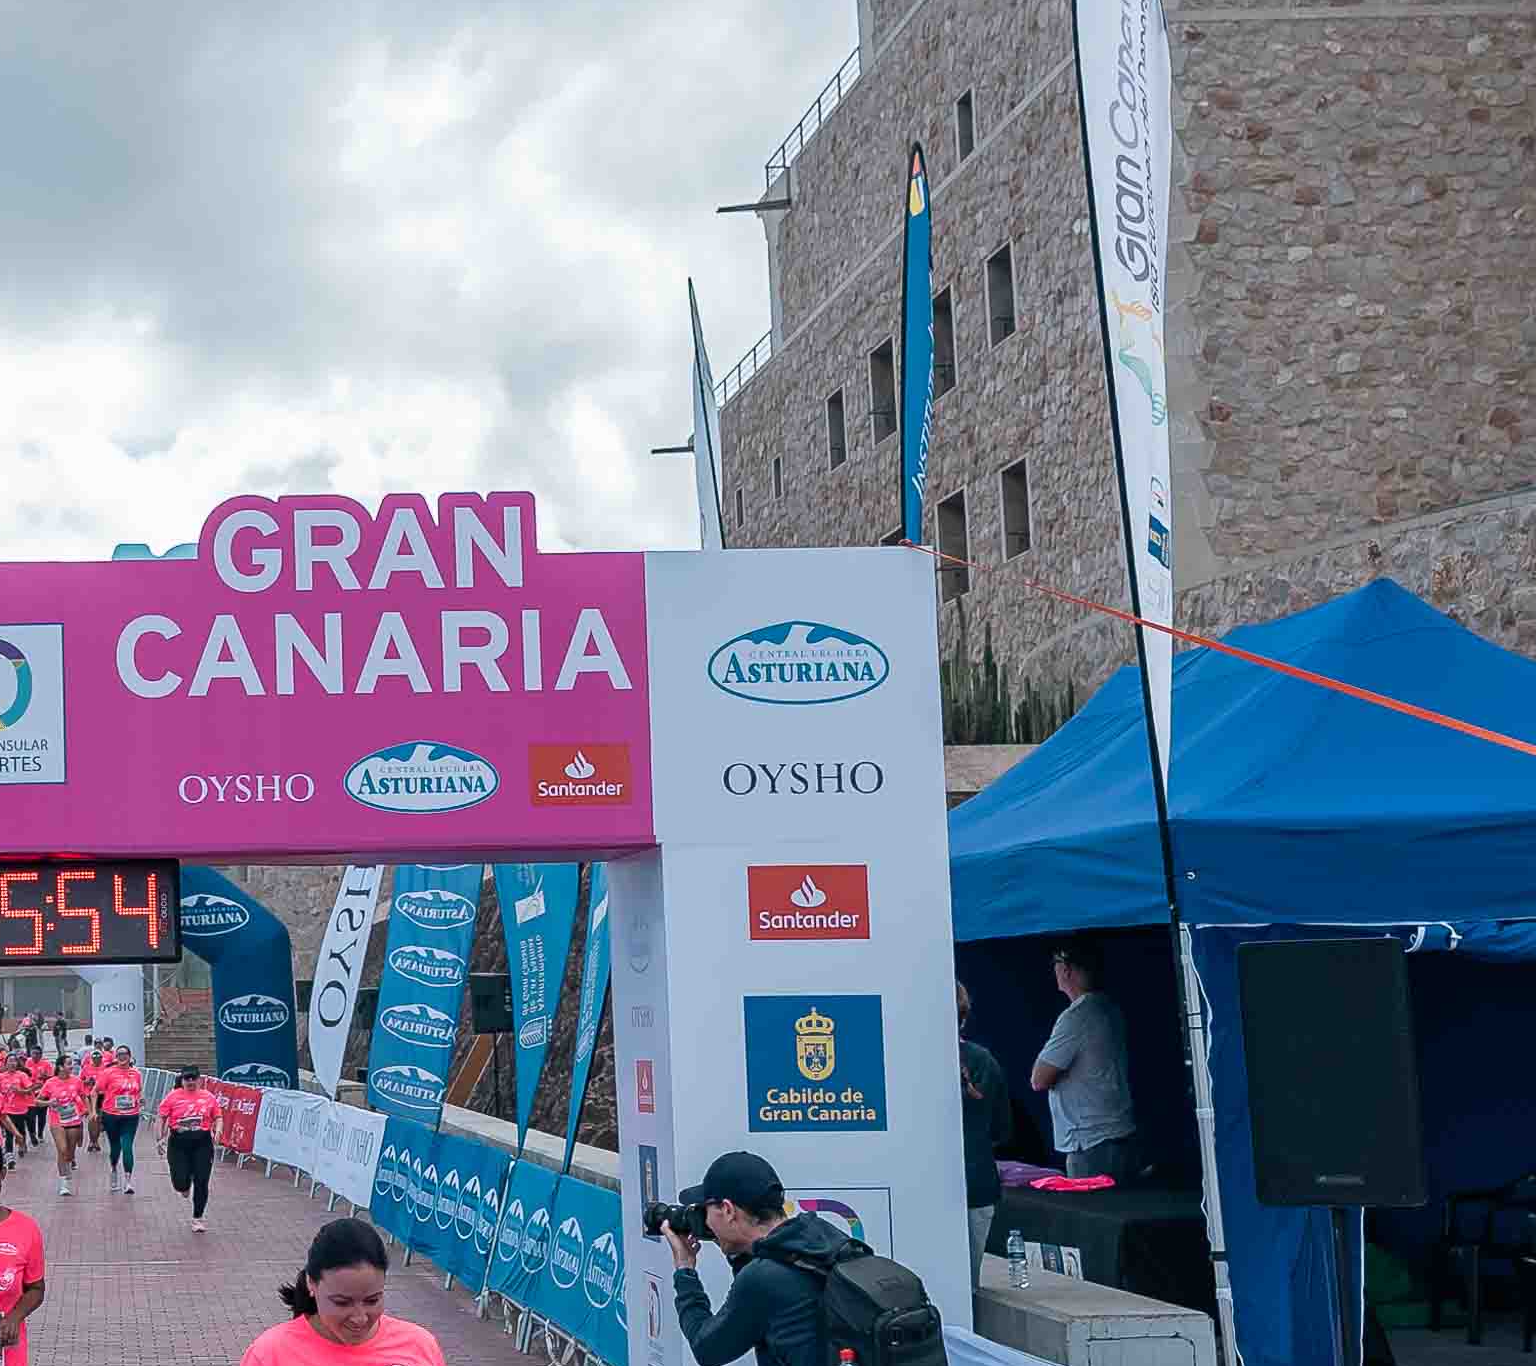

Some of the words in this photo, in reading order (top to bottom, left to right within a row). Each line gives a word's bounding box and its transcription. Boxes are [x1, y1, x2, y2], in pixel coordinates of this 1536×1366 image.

[1114, 153, 1149, 282] Gran
[213, 506, 523, 593] GRAN
[114, 607, 632, 698] CANARIA
[722, 652, 877, 683] ASTURIANA
[179, 773, 315, 804] OYSHO
[358, 768, 487, 795] ASTURIANA
[538, 781, 623, 796] Santander
[723, 762, 883, 795] OYSHO
[759, 912, 859, 930] Santander
[223, 1009, 285, 1025] ASTURIANA
[766, 1087, 836, 1104] Cabildo
[840, 1088, 863, 1104] de
[759, 1106, 803, 1122] Gran
[807, 1105, 876, 1121] Canaria
